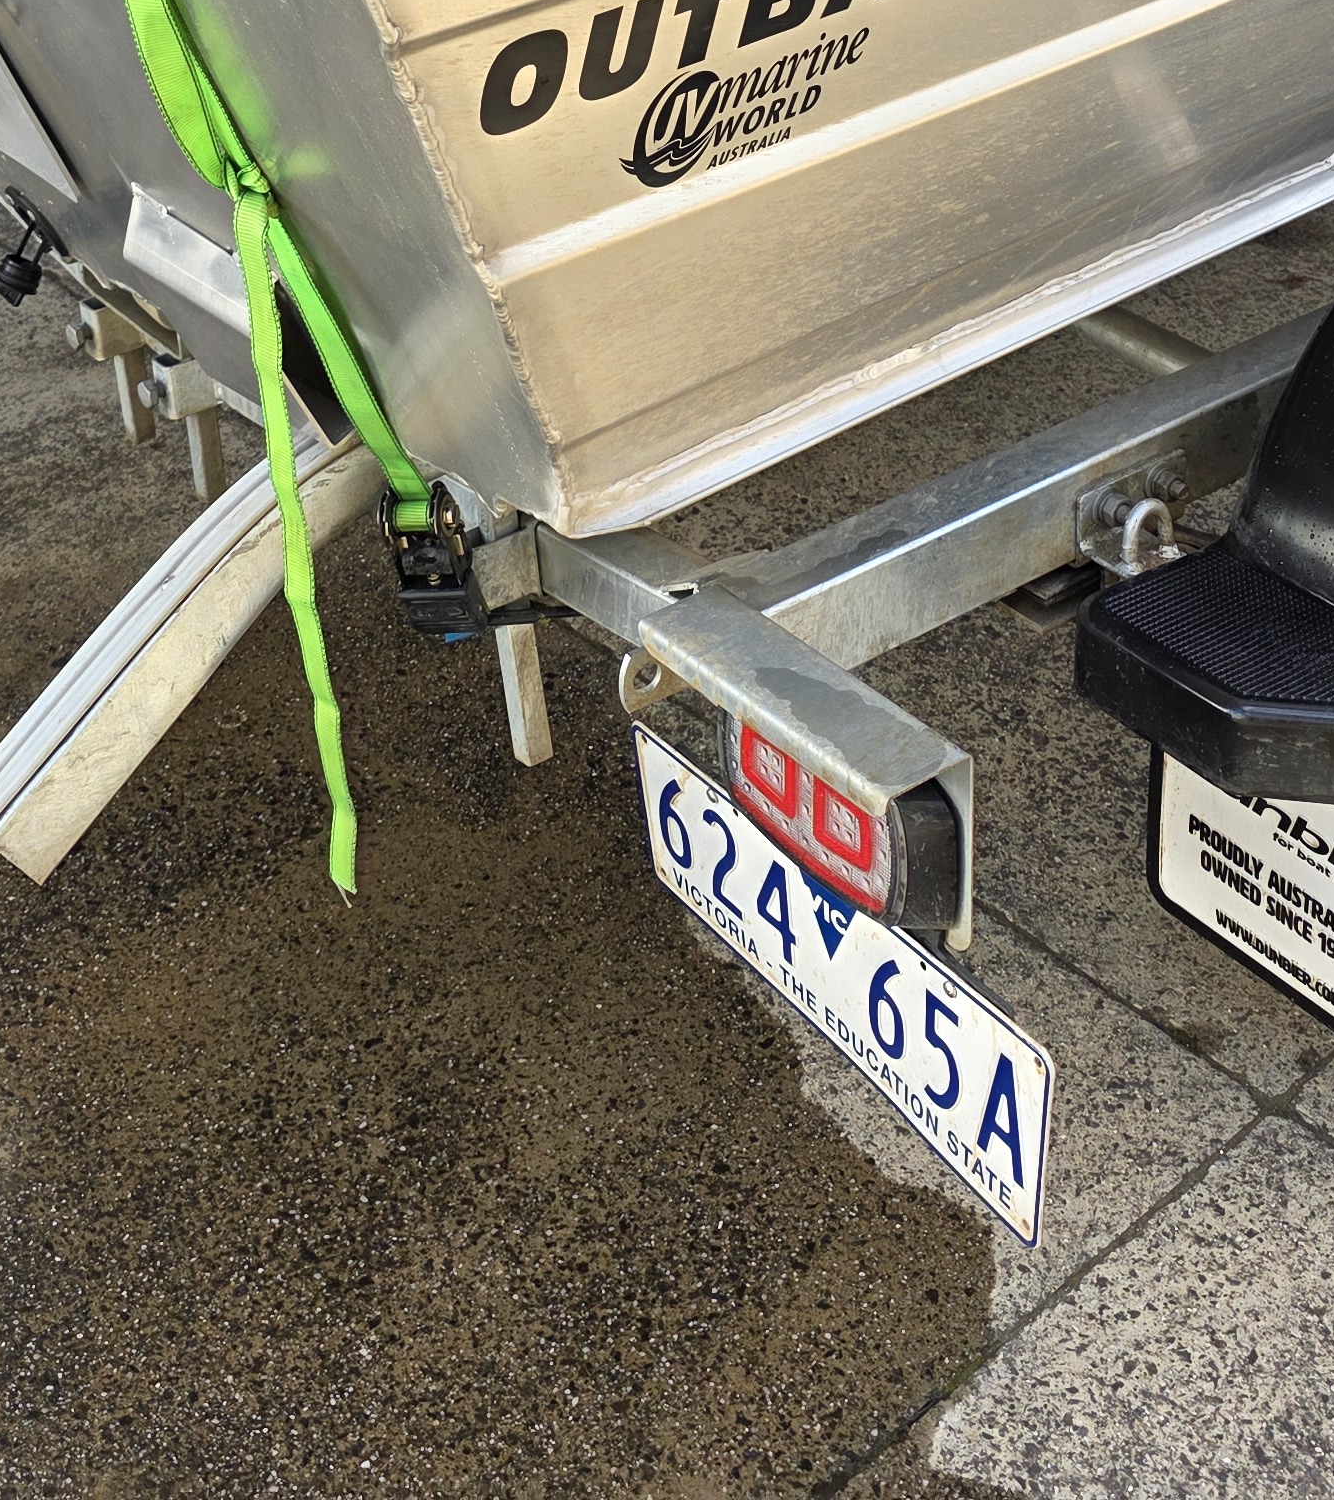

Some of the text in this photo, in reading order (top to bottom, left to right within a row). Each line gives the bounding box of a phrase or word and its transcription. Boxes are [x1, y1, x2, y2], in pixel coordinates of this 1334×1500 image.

[716, 27, 870, 114] marine
[706, 126, 792, 170] AUSTRALIA
[713, 84, 822, 148] WORLD
[1188, 813, 1264, 881] PROUDLY
[1272, 832, 1294, 851] for
[1297, 847, 1331, 878] boat
[812, 894, 848, 936] VIC
[1200, 850, 1262, 907] OWNED
[1266, 895, 1313, 944] SINCE
[659, 779, 1023, 1189] 624 65A
[672, 867, 760, 961] VICTORIA
[779, 964, 818, 1015] THE
[824, 1005, 939, 1137] EDUCATION
[946, 1130, 1011, 1211] STATE
